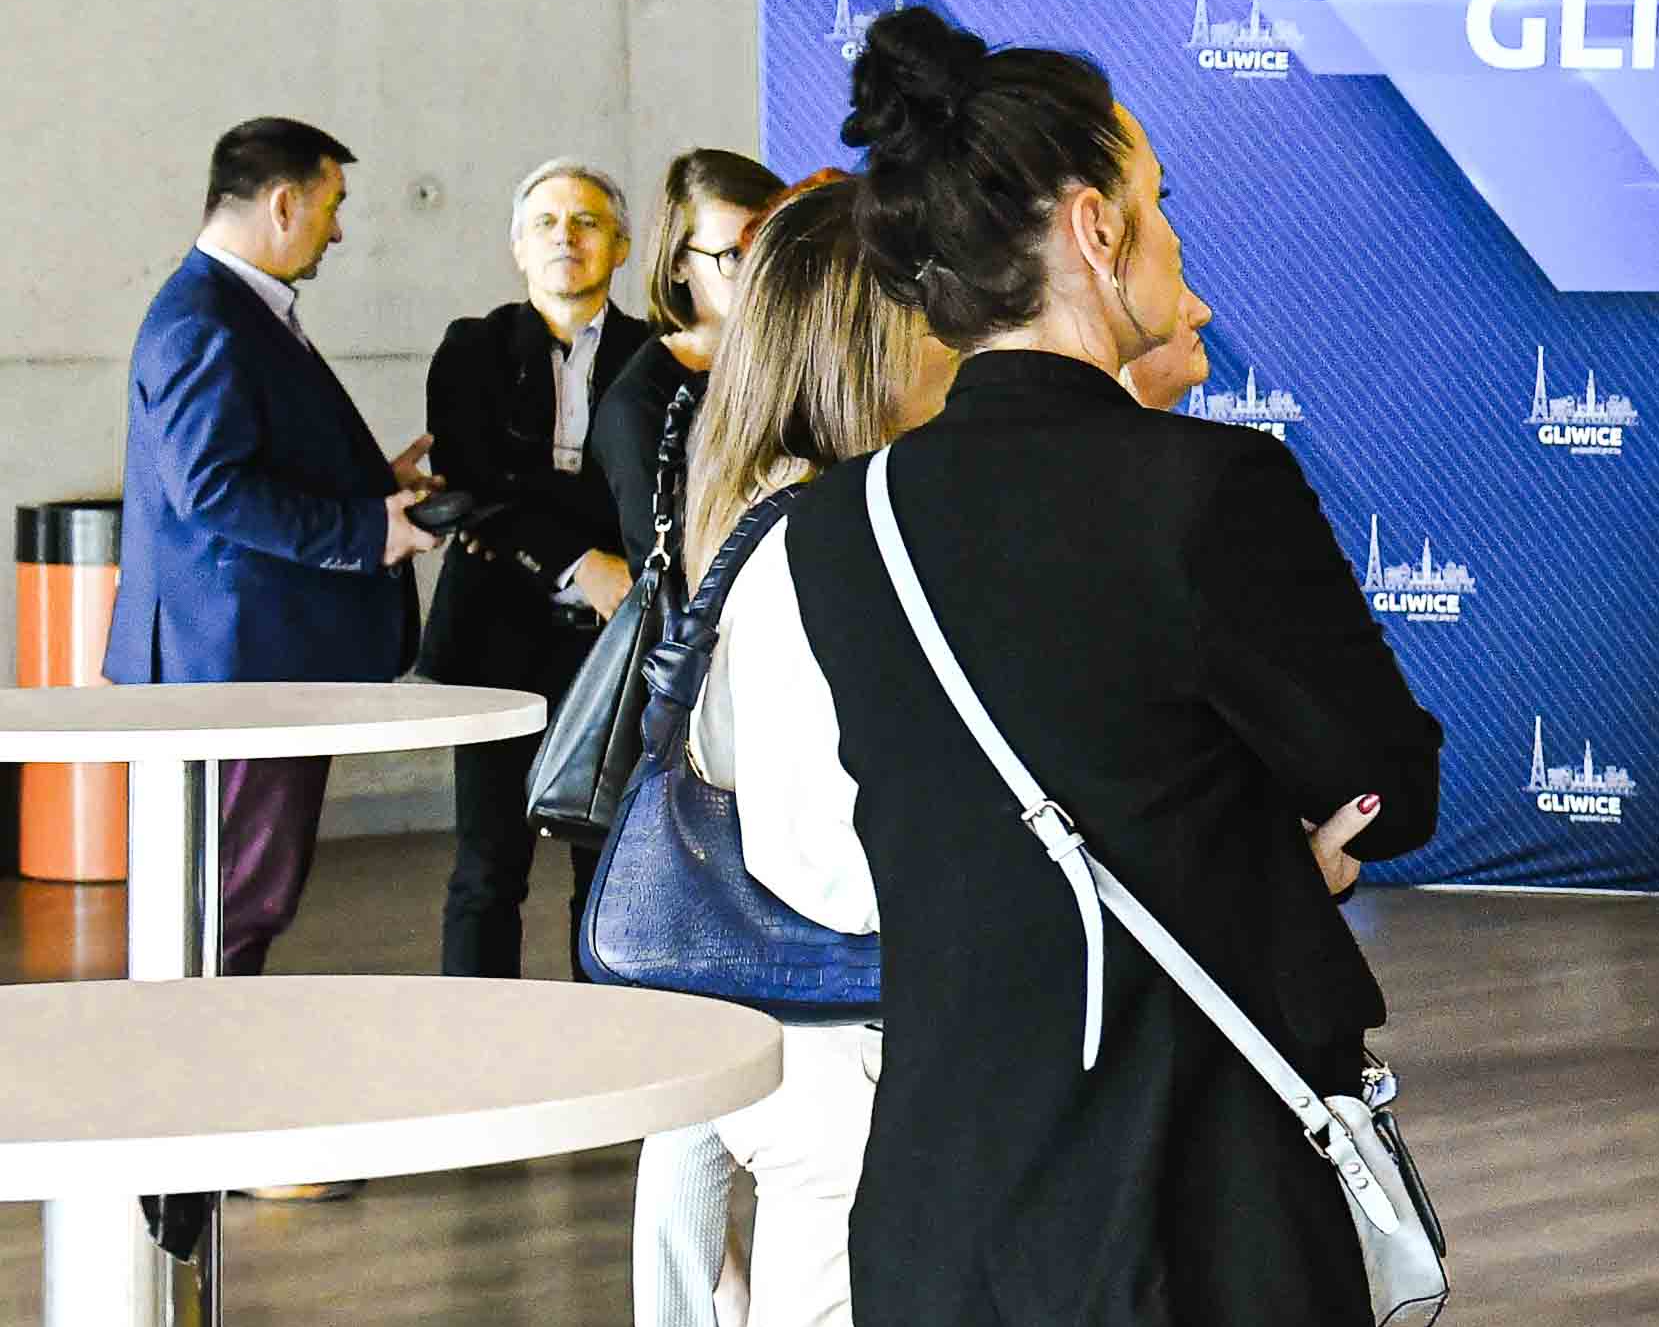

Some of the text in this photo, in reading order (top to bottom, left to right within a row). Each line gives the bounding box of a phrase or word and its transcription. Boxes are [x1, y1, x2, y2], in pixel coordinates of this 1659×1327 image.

[1199, 49, 1289, 71] GLIWICE
[1538, 425, 1623, 446] GLIWICE
[1373, 592, 1461, 614] GLIWICE
[1537, 793, 1622, 815] GLIWICE
